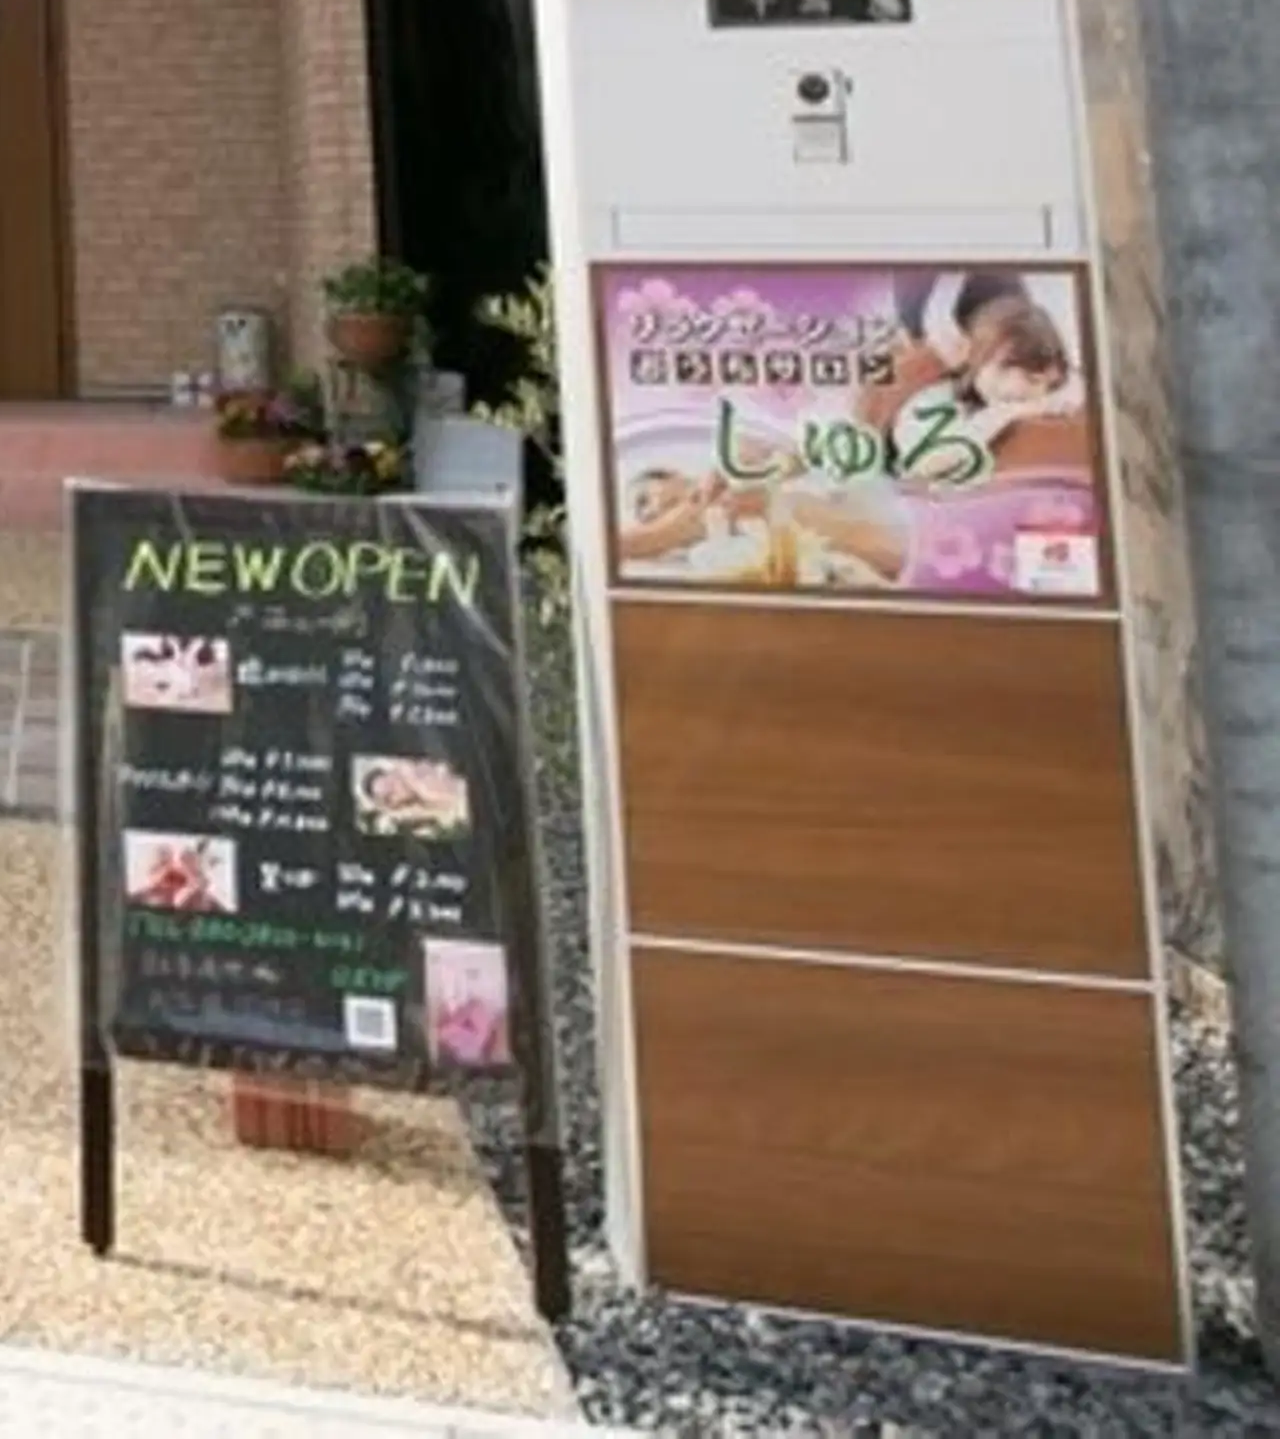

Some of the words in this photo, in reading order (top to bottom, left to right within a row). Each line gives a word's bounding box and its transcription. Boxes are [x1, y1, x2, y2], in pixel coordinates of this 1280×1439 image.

[717, 397, 991, 485] しゅろ
[123, 538, 285, 594] NEW
[290, 539, 481, 608] OPEN
